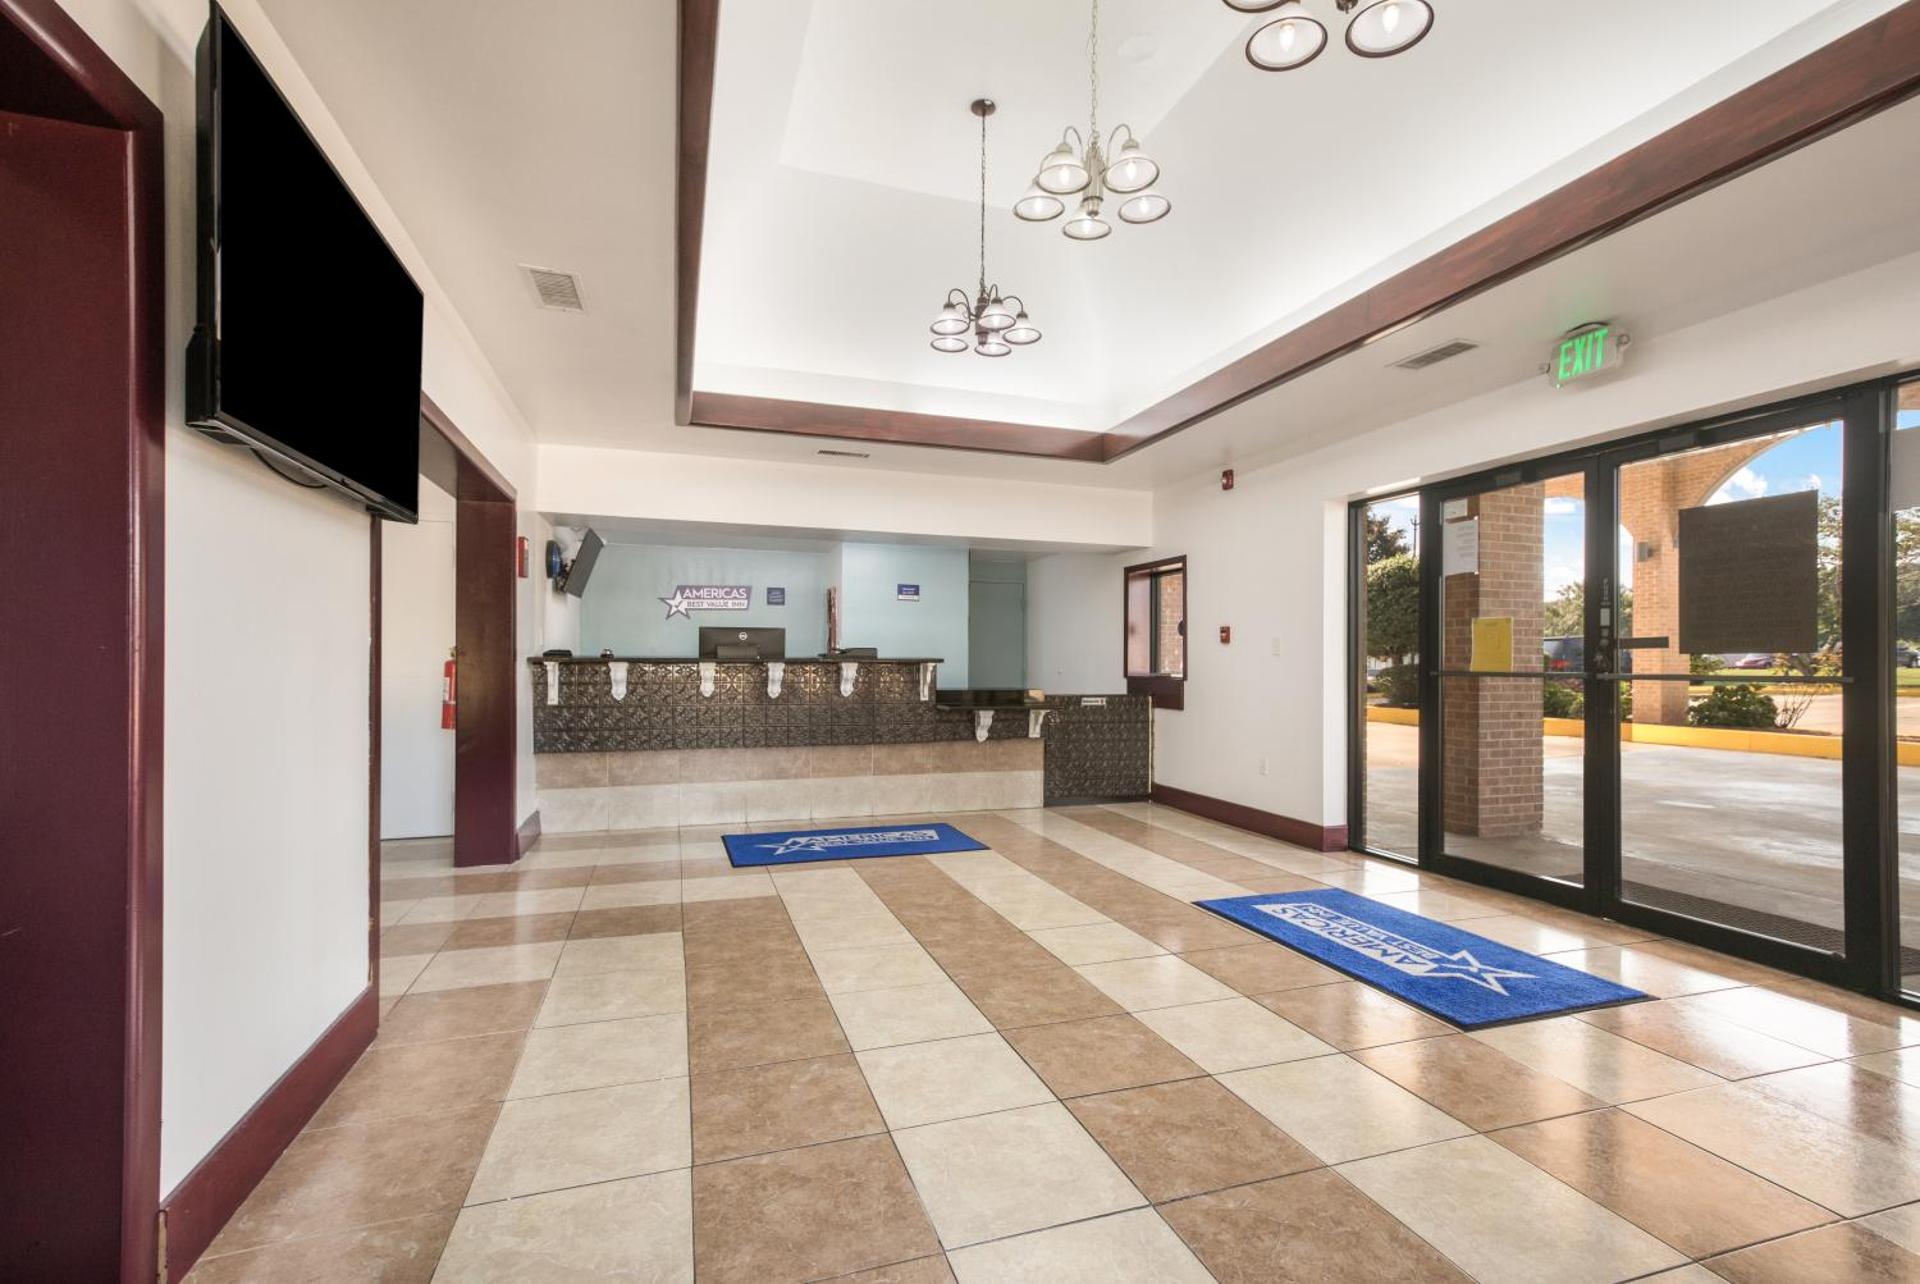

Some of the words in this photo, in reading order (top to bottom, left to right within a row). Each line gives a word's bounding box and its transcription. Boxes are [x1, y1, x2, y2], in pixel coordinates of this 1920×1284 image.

[1558, 328, 1608, 380] EXIT
[682, 587, 747, 599] AMERICAS
[1272, 907, 1430, 966] AMERICAS
